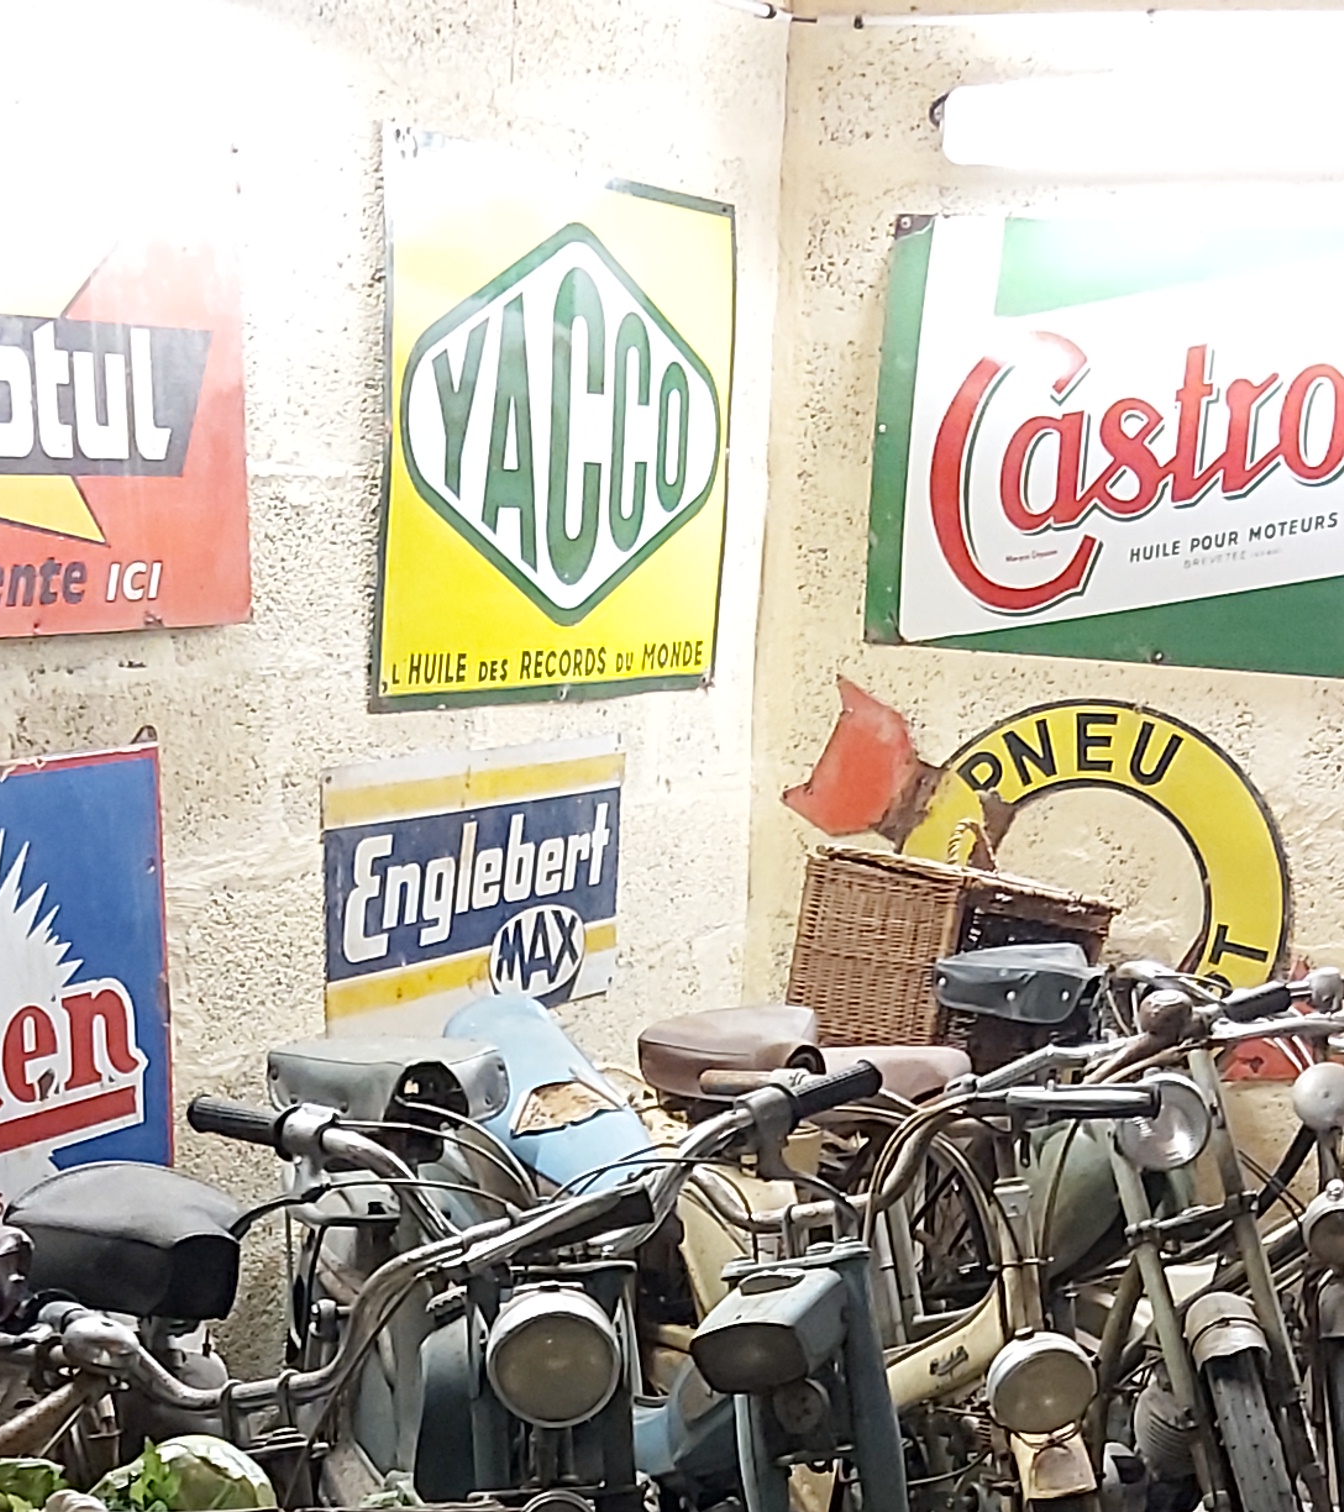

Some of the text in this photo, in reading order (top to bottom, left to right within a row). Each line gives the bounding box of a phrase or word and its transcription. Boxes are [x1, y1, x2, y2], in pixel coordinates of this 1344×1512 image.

[432, 267, 690, 585] YACCO
[1129, 539, 1182, 563] HUILE
[1189, 530, 1240, 553] POUR
[1248, 512, 1340, 543] MOTEURS
[408, 652, 467, 685] HUILE
[478, 659, 509, 683] DES
[519, 646, 607, 680] RECORDS
[615, 652, 634, 674] DU
[640, 640, 704, 672] MONDE
[956, 712, 1185, 792] PNEU
[343, 801, 611, 963] Englebert
[496, 909, 579, 991] MAX
